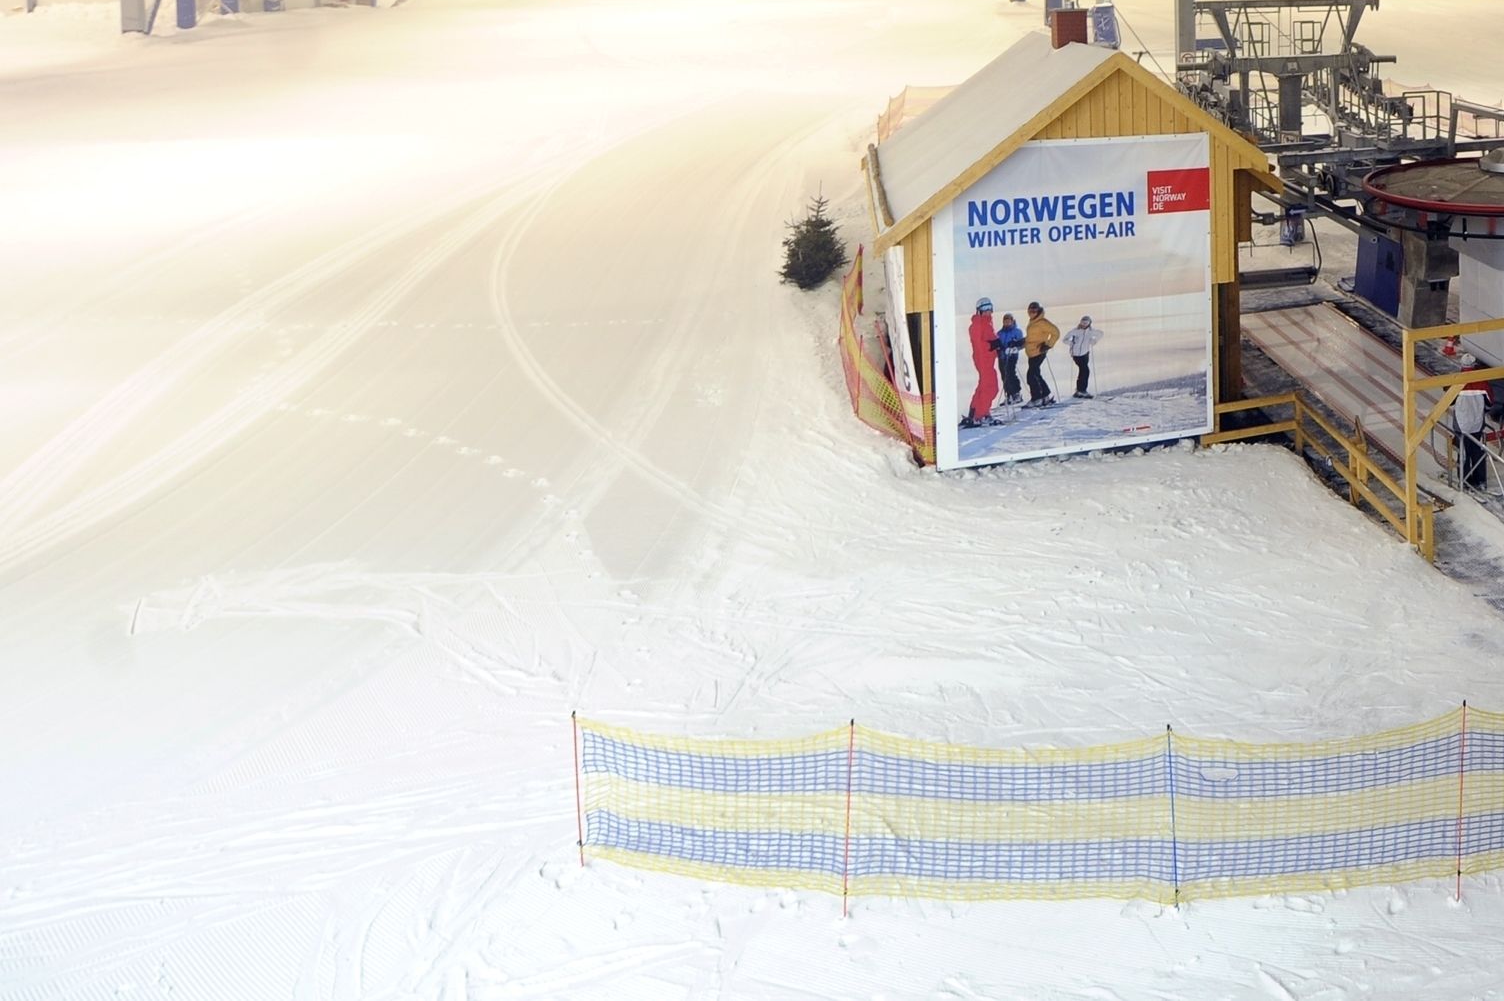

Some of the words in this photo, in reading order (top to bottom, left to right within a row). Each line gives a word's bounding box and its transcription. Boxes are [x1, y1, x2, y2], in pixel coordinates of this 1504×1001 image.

[1151, 185, 1172, 195] VISIT
[1152, 192, 1187, 203] NORWAY
[968, 191, 1135, 227] NORWEGEN
[967, 227, 1041, 249] WINTER
[1048, 221, 1136, 243] OPEN-AIR
